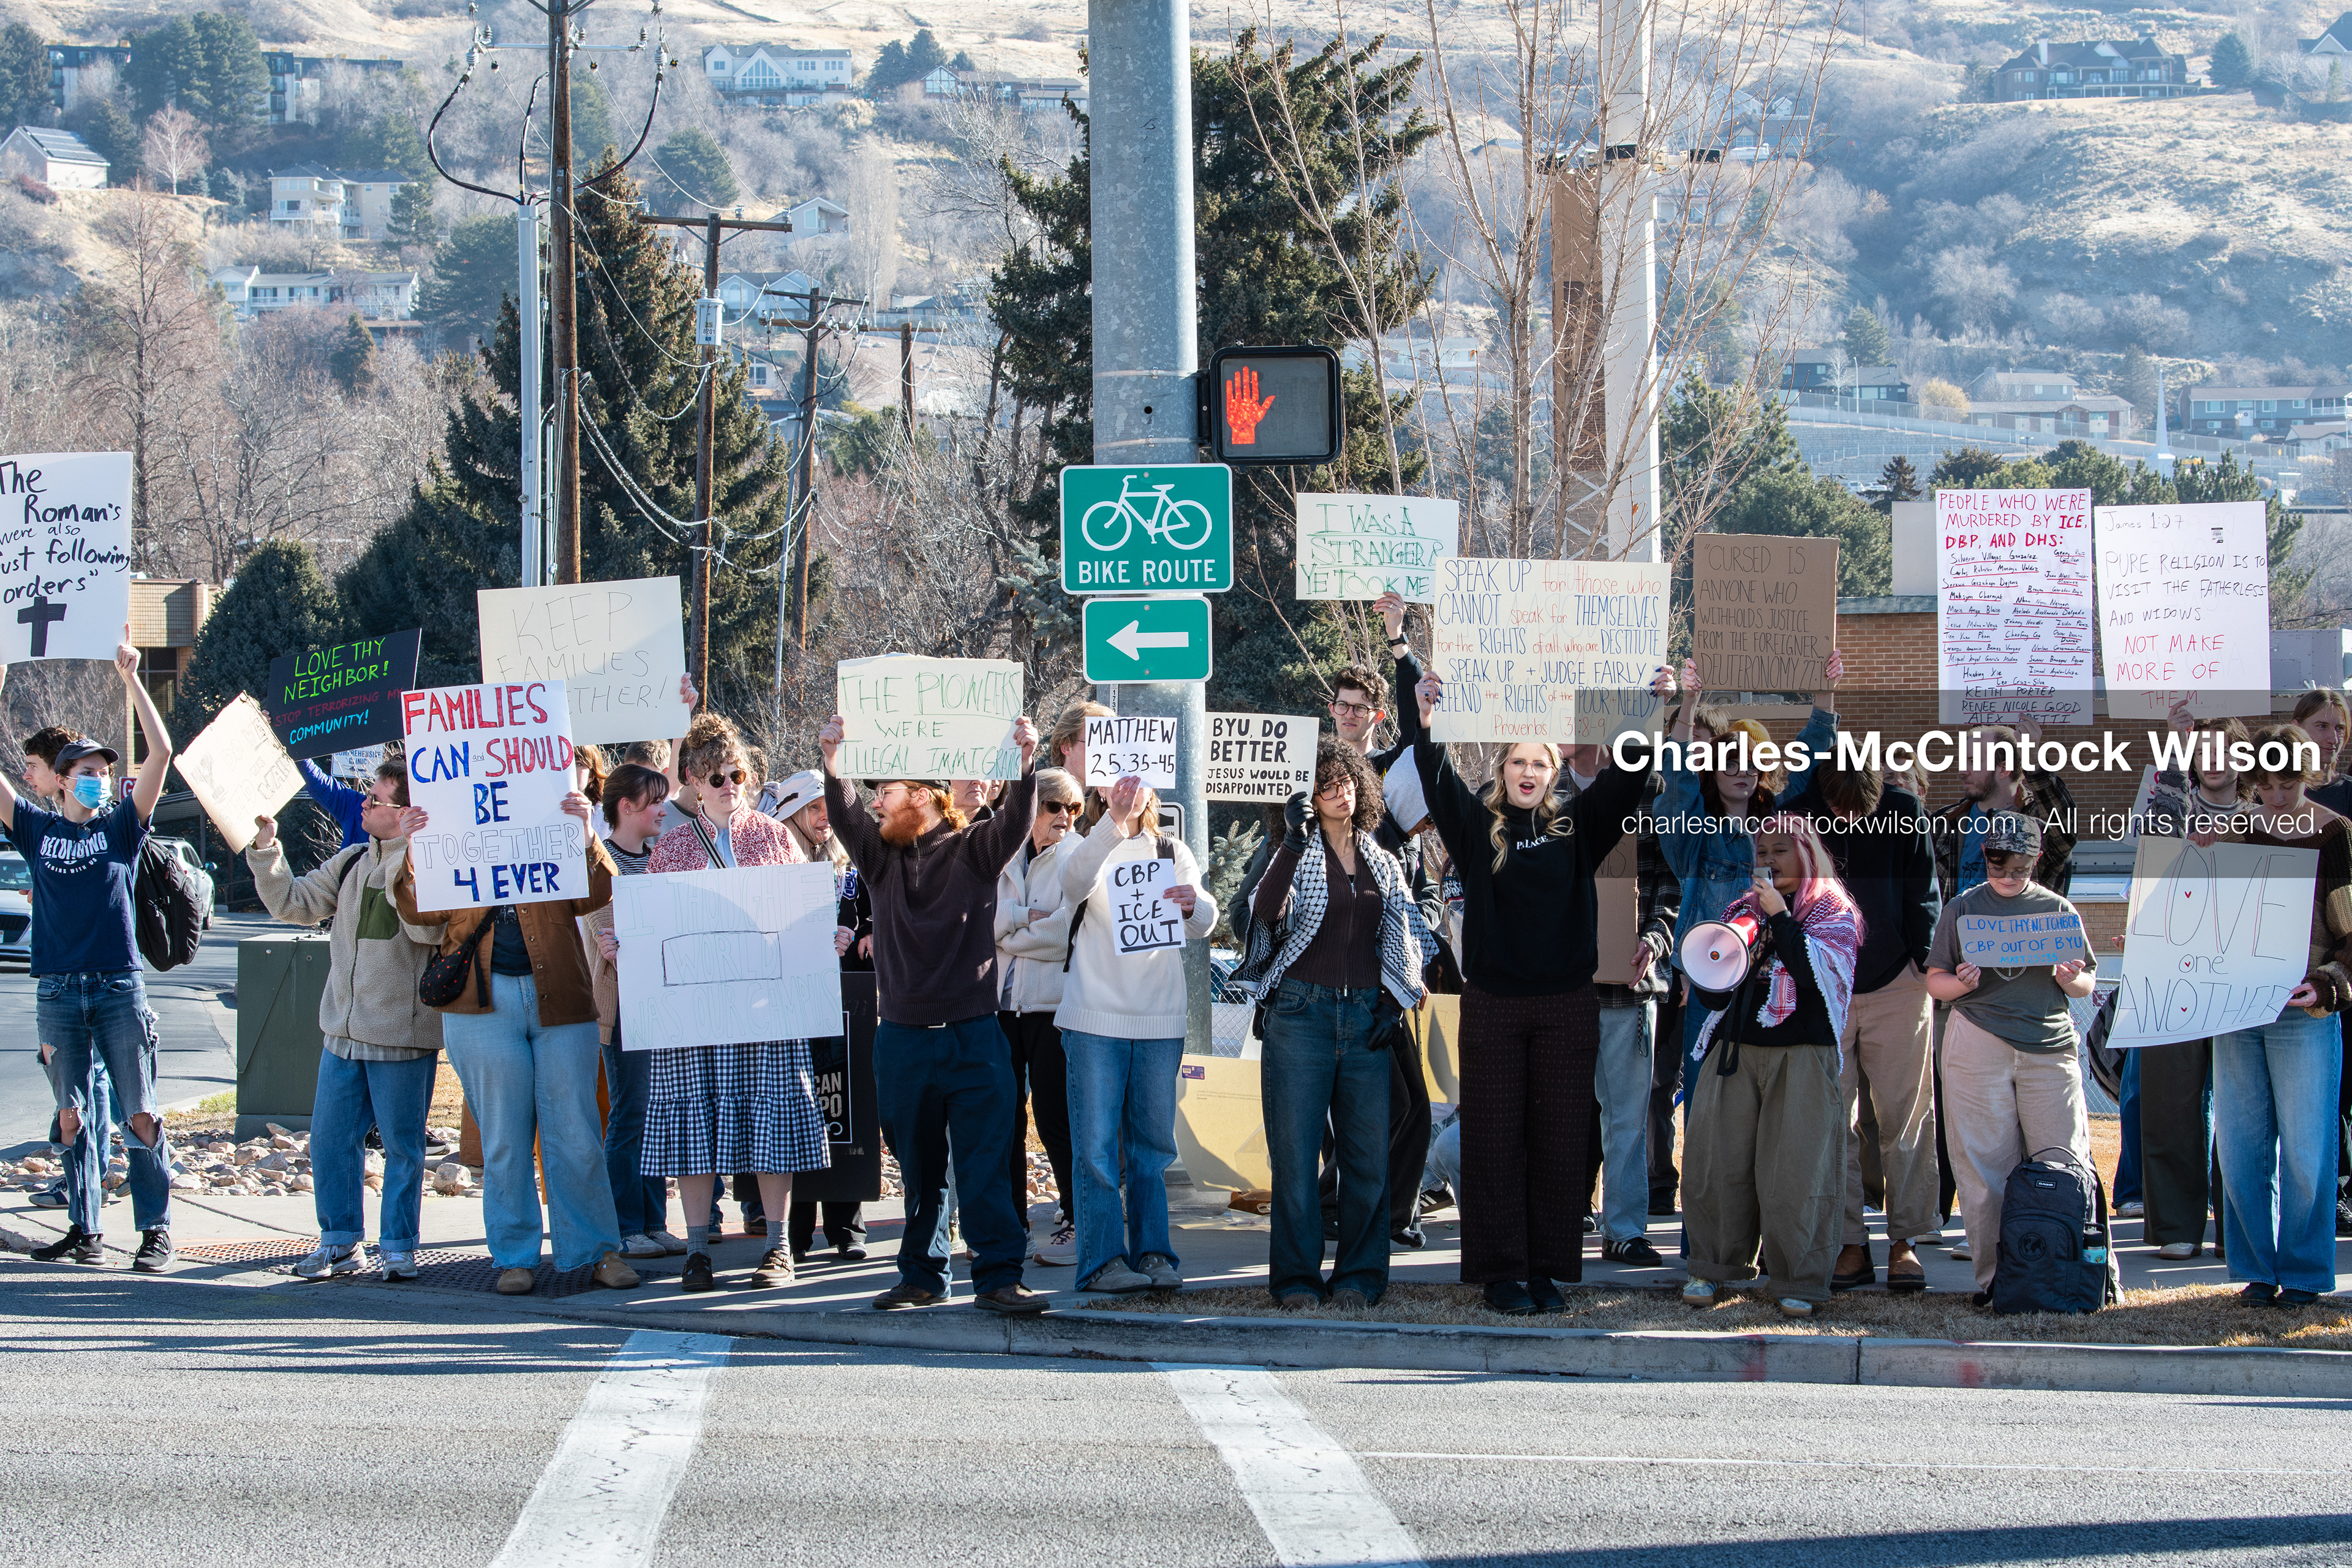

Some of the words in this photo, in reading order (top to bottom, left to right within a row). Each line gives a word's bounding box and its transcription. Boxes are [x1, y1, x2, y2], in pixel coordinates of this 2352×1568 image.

[0, 461, 47, 494] The
[24, 494, 121, 524] Roman's
[1940, 493, 1989, 510] PEOPLE
[1999, 494, 2035, 509] WHO
[2046, 494, 2086, 511] WERE
[1316, 503, 1341, 534] I
[1347, 504, 1396, 535] WAS
[1400, 505, 1415, 536] A
[1946, 513, 2021, 529] MURDERED
[2031, 514, 2051, 528] BY
[2059, 514, 2087, 529] ICE,
[2103, 511, 2141, 531] James
[2151, 512, 2184, 529] 1:27
[0, 528, 37, 545] were
[48, 522, 80, 535] also
[1990, 533, 2016, 548] AND
[2026, 532, 2063, 547] DHS:
[0, 546, 36, 574] ust
[46, 537, 130, 572] following
[1310, 537, 1425, 567] STRANGER
[1428, 541, 1444, 567] &
[1787, 546, 1806, 575] IS
[2106, 551, 2149, 578] PURE
[2160, 554, 2224, 575] RELIGION
[2233, 555, 2248, 568] IS
[2254, 556, 2265, 568] TO
[1079, 560, 1130, 583] BIKE
[1142, 559, 1216, 582] ROUTE
[1446, 560, 1499, 592] SPEAK
[1509, 560, 1532, 592] UP
[1542, 562, 1566, 592] for
[1575, 565, 1618, 595] those
[1627, 570, 1661, 594] who
[1404, 576, 1429, 597] ME
[1700, 579, 1755, 603] ANYONE
[1763, 581, 1798, 604] WHO
[2106, 582, 2151, 600] VISIT
[2163, 580, 2190, 595] THE
[2201, 579, 2266, 598] FATHERLESS
[513, 592, 632, 656] KEEP
[1439, 594, 1502, 625] CANNOT
[1510, 605, 1545, 626] speak
[1550, 603, 1567, 624] for
[1574, 595, 1659, 628] THEMSELVES
[1699, 607, 1763, 628] WITHHOLDS
[1767, 608, 1809, 633] JUSTICE
[2109, 610, 2133, 627] AND
[2143, 607, 2205, 621] WIDOWS.
[1435, 628, 1452, 652] for
[1455, 633, 1474, 653] the
[1479, 627, 1526, 655] RIGHTS
[1532, 633, 1544, 654] of
[1545, 633, 1560, 654] all
[1564, 638, 1583, 652] who
[1585, 643, 1600, 652] are
[1600, 629, 1662, 656] DESTITUTE
[1698, 630, 1724, 650] FROM
[1730, 631, 1747, 652] THE
[2124, 634, 2159, 654] NOT
[2169, 634, 2225, 653] MAKE
[295, 645, 346, 676] LOVE
[352, 637, 385, 662] THY
[497, 650, 649, 682] FAMILIES
[284, 660, 389, 704] NEIGHBOR!
[1449, 658, 1491, 684] SPEAK
[1496, 660, 1514, 683] UP
[1526, 667, 1536, 676] +
[1540, 660, 1586, 685] JUDGE
[1594, 660, 1647, 685] FAIRLY
[1701, 653, 1799, 690] DEUTERONOMY
[2117, 662, 2176, 682] MORE
[2192, 662, 2220, 679] OF
[838, 674, 902, 714] THE
[915, 671, 1022, 718] PIONEERS
[1485, 690, 1499, 700] the
[1505, 684, 1547, 714] RIGHTS
[1548, 690, 1558, 702] of
[1559, 690, 1574, 701] the
[1578, 685, 1610, 715] POOR
[1617, 686, 1659, 718] NEEDY
[1966, 686, 2002, 697] KEITH
[2016, 687, 2055, 696] PORTER
[2141, 690, 2203, 709] THEM.
[276, 710, 301, 726] STOP
[307, 692, 380, 717] TERRORIZING
[387, 687, 403, 700] MY
[403, 683, 548, 735] FAMILIES
[1962, 700, 1996, 712] RENEE
[2003, 701, 2037, 712] NICOLE
[2045, 702, 2081, 712] GOOD
[1968, 712, 2003, 723] ALEX
[290, 709, 369, 744] COMMUNITY!
[875, 719, 949, 737] WERE
[1087, 718, 1176, 747] MATTHEW
[1213, 718, 1253, 739] BYU,
[1262, 719, 1287, 739] DO
[1494, 714, 1548, 736] Proverbs
[1564, 717, 1605, 737] 31:8-9
[411, 741, 470, 783] CAN
[485, 735, 574, 777] SHOULD
[841, 739, 918, 775] ILLEGAL
[926, 745, 1022, 779] IMMIGRANTS
[1091, 753, 1175, 777] 25:35-45
[1210, 741, 1291, 763] BETTER.
[1207, 768, 1245, 780] JESUS
[1250, 770, 1290, 780] WOULD
[1295, 771, 1310, 782] BE
[1206, 782, 1294, 797] DISAPPOINTED.
[473, 781, 510, 825] BE
[413, 823, 582, 869] TOGETHER
[45, 862, 67, 873] BEGINS
[70, 864, 87, 873] WITH
[1114, 861, 1160, 887] CBP
[454, 867, 481, 902] 4
[491, 862, 560, 899] EVER
[1130, 889, 1145, 901] +
[618, 880, 654, 937] I
[666, 864, 800, 934] THOUGHT
[1118, 900, 1164, 922] ICE
[2132, 839, 2296, 960] LOVE
[1120, 919, 1178, 946] OUT
[1967, 919, 2006, 932] LOVE
[2008, 919, 2030, 933] THY
[2032, 914, 2080, 932] NEIGHBOR
[668, 933, 778, 984] WORLD
[1965, 940, 1995, 954] CBP
[2001, 940, 2026, 952] OUT
[2029, 938, 2048, 951] OF
[2056, 937, 2082, 949] BYU
[2000, 955, 2025, 964] MATT
[2027, 952, 2057, 963] 25:35
[2179, 954, 2228, 974] one
[620, 990, 683, 1047] WAS
[693, 984, 745, 1039] OUR
[747, 968, 840, 1037] CAMPUS
[2110, 974, 2291, 1036] ANOTHER
